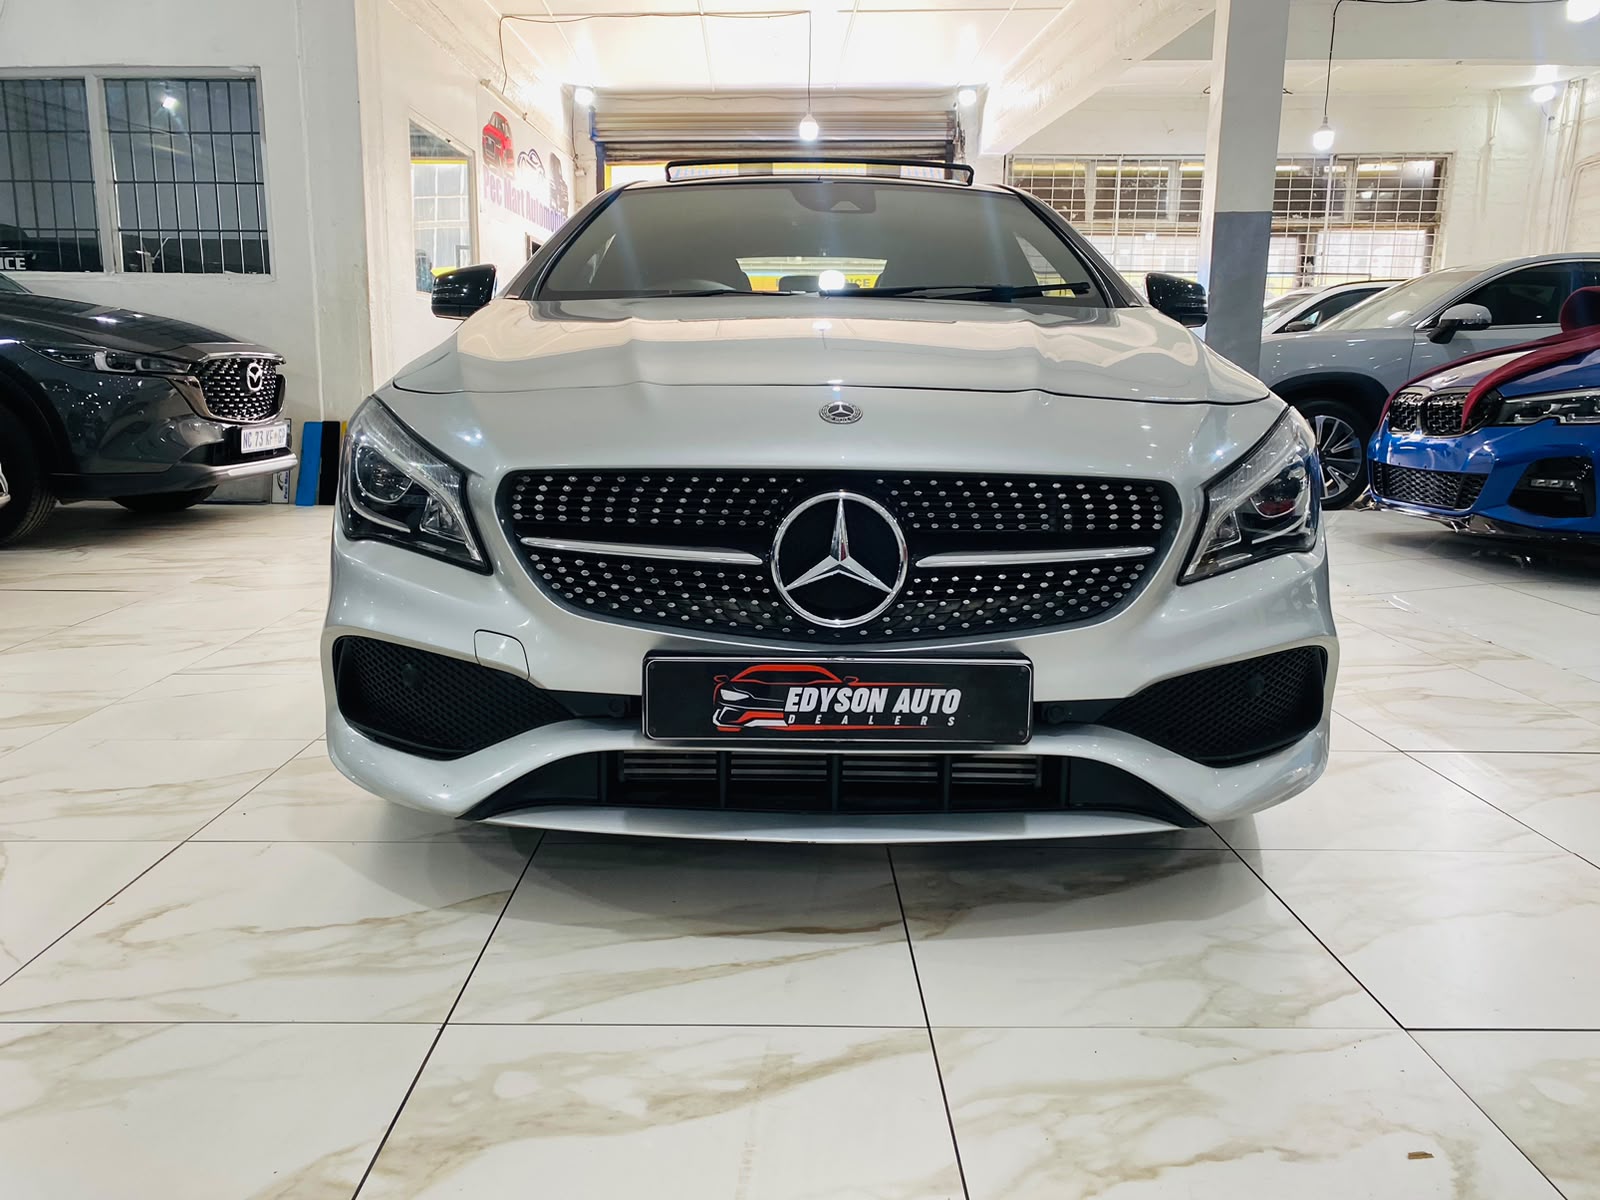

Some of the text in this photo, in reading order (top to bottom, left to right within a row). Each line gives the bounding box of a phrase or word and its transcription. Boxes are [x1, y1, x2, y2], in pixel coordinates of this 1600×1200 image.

[503, 176, 525, 217] Mart
[243, 431, 252, 448] NC
[255, 431, 264, 447] 73
[784, 687, 962, 714] EDYSON AUTO
[787, 714, 956, 726] DEALERS
